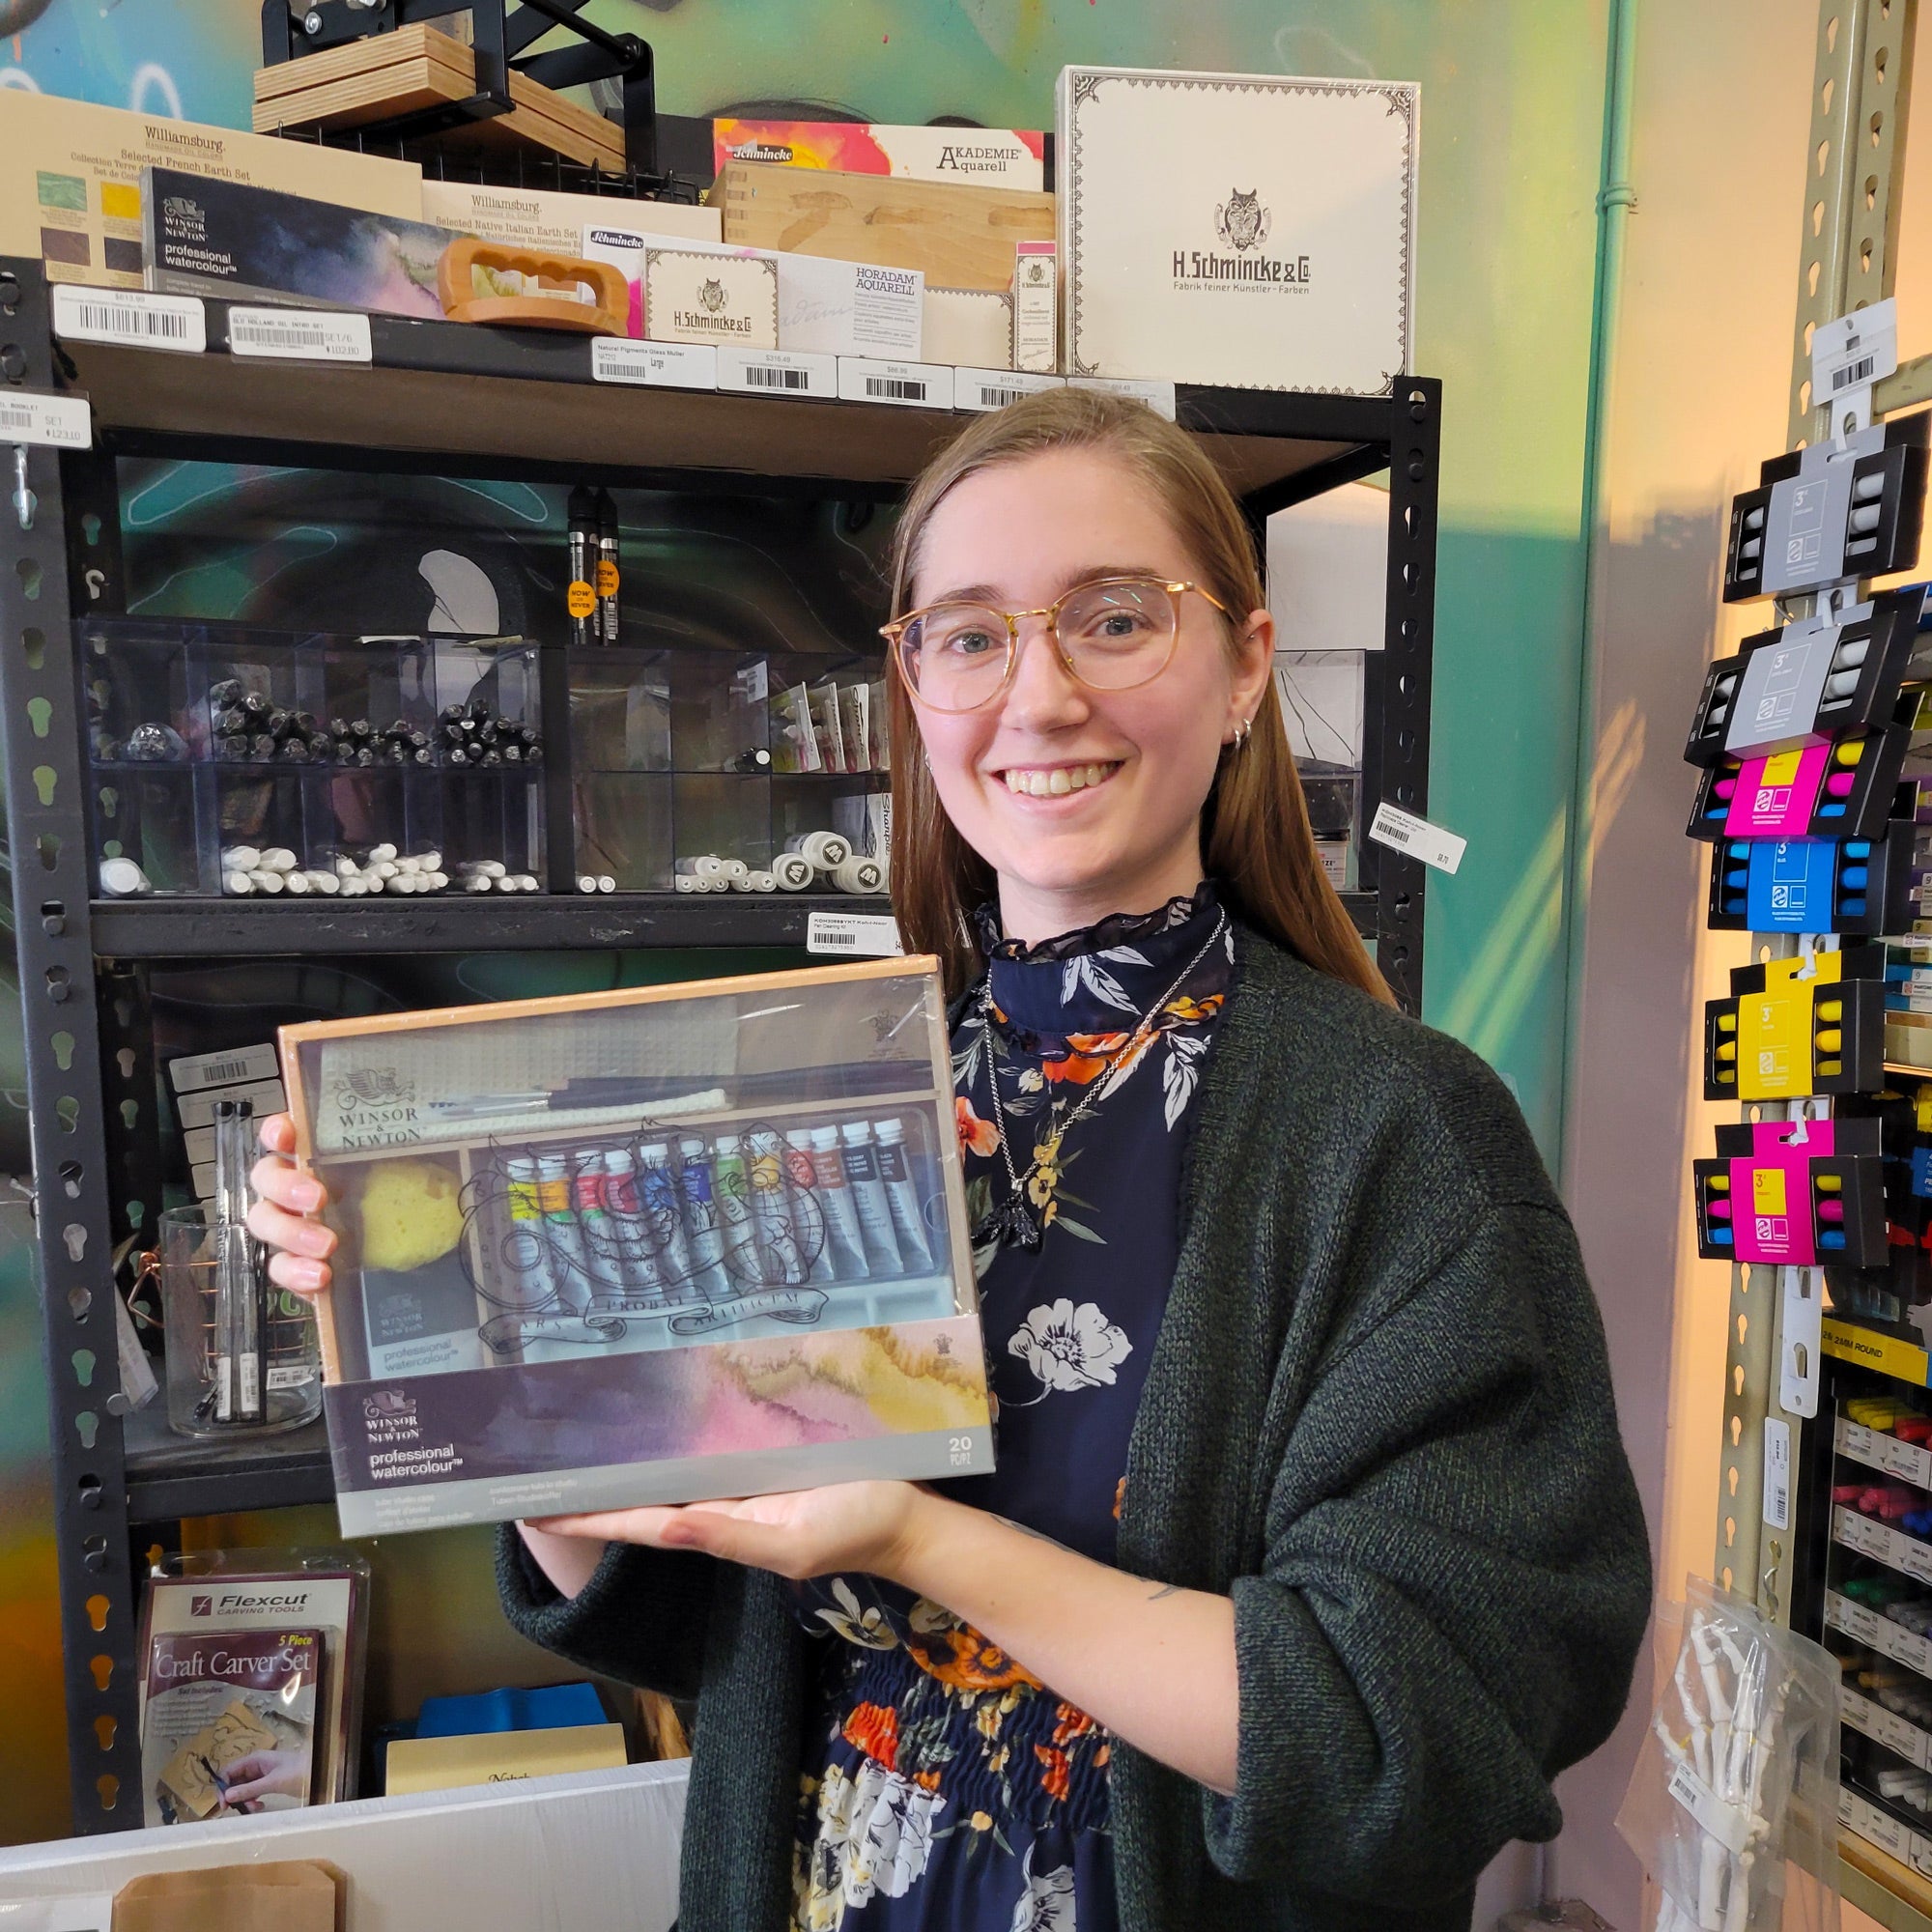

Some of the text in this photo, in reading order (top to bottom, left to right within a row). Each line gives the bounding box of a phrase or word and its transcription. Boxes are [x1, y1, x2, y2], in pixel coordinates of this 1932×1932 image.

[71, 152, 112, 168] Collection
[121, 149, 250, 182] Selected French Earth Set
[165, 216, 205, 231] WINSOR
[436, 216, 578, 239] Selected Native Italian Earth Set
[165, 227, 206, 242] NEWTON
[165, 243, 231, 265] professional
[856, 268, 915, 285] HORADAM
[856, 278, 915, 296] AQUARELL
[1174, 281, 1202, 291] Fabrik
[1204, 282, 1231, 292] feiner
[1279, 285, 1310, 295] Farben
[620, 346, 648, 355] Pigments
[339, 1107, 418, 1127] WINSOR
[341, 1128, 421, 1150] NEWTON
[384, 1339, 452, 1363] professional
[1855, 1343, 1883, 1358] ROUND
[365, 1414, 418, 1432] WINSOR
[367, 1429, 419, 1444] NEWTON
[949, 1435, 973, 1452] 20
[370, 1443, 455, 1468] professional
[219, 1594, 308, 1607] Flexcut
[278, 1634, 313, 1646] 5 Piece
[156, 1648, 311, 1679] Craft Carver Set
